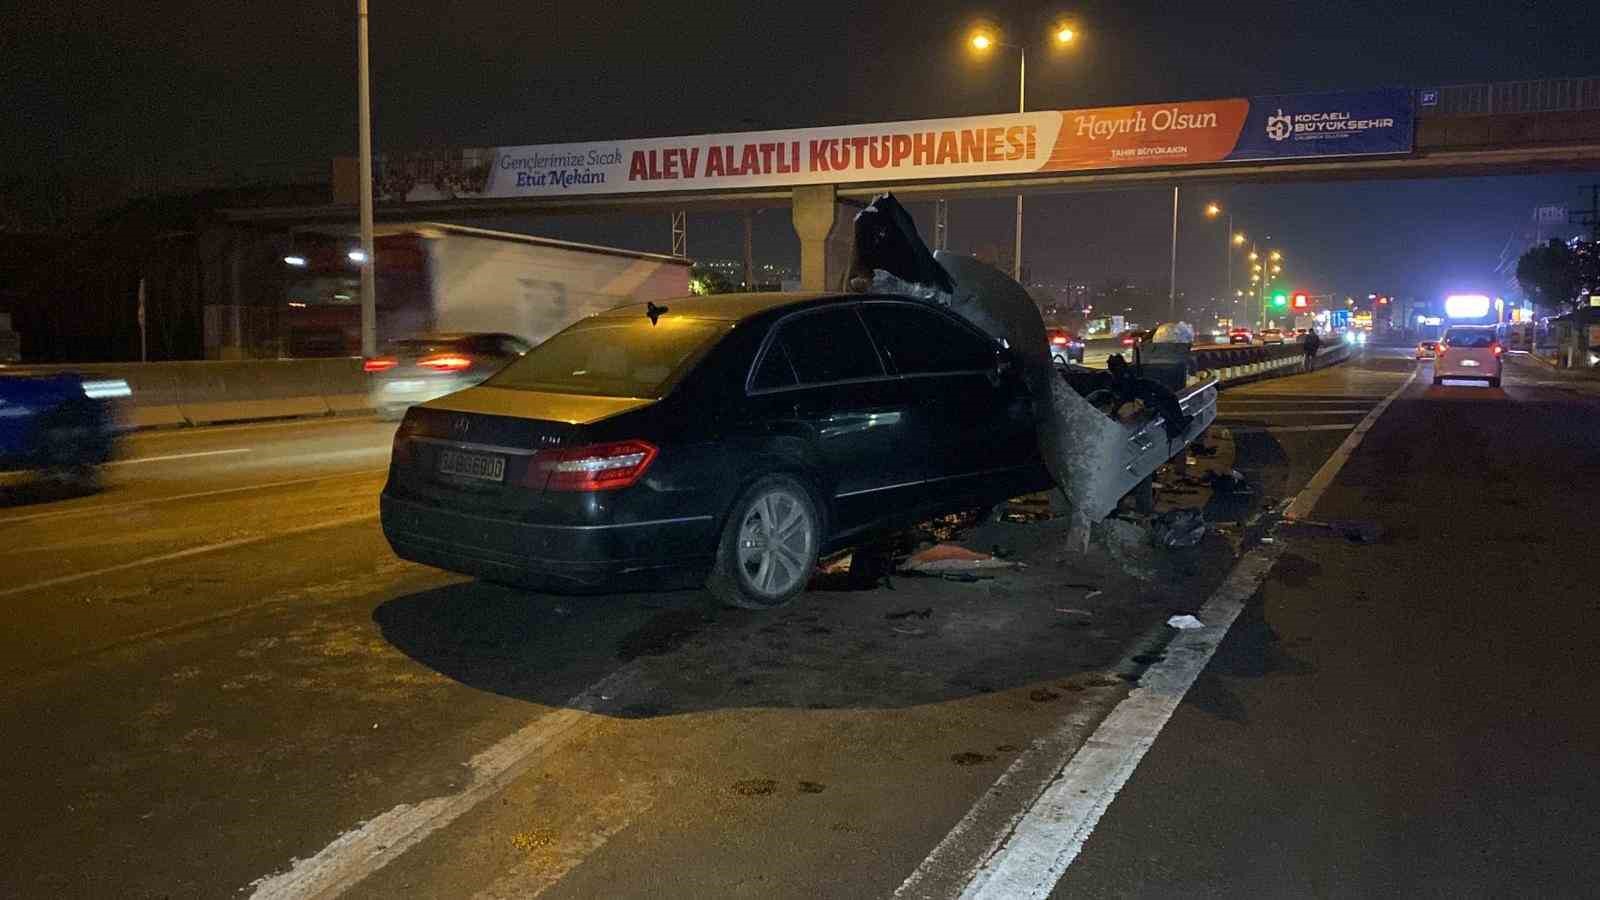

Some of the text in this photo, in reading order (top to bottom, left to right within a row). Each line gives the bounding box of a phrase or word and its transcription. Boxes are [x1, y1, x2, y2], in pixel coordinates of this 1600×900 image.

[1074, 108, 1217, 140] Hayırlı Olsun
[501, 148, 623, 174] Gençlerimize Sıcak
[628, 147, 699, 181] ALEV
[704, 141, 800, 177] ALATLI
[516, 171, 547, 187] Etüt
